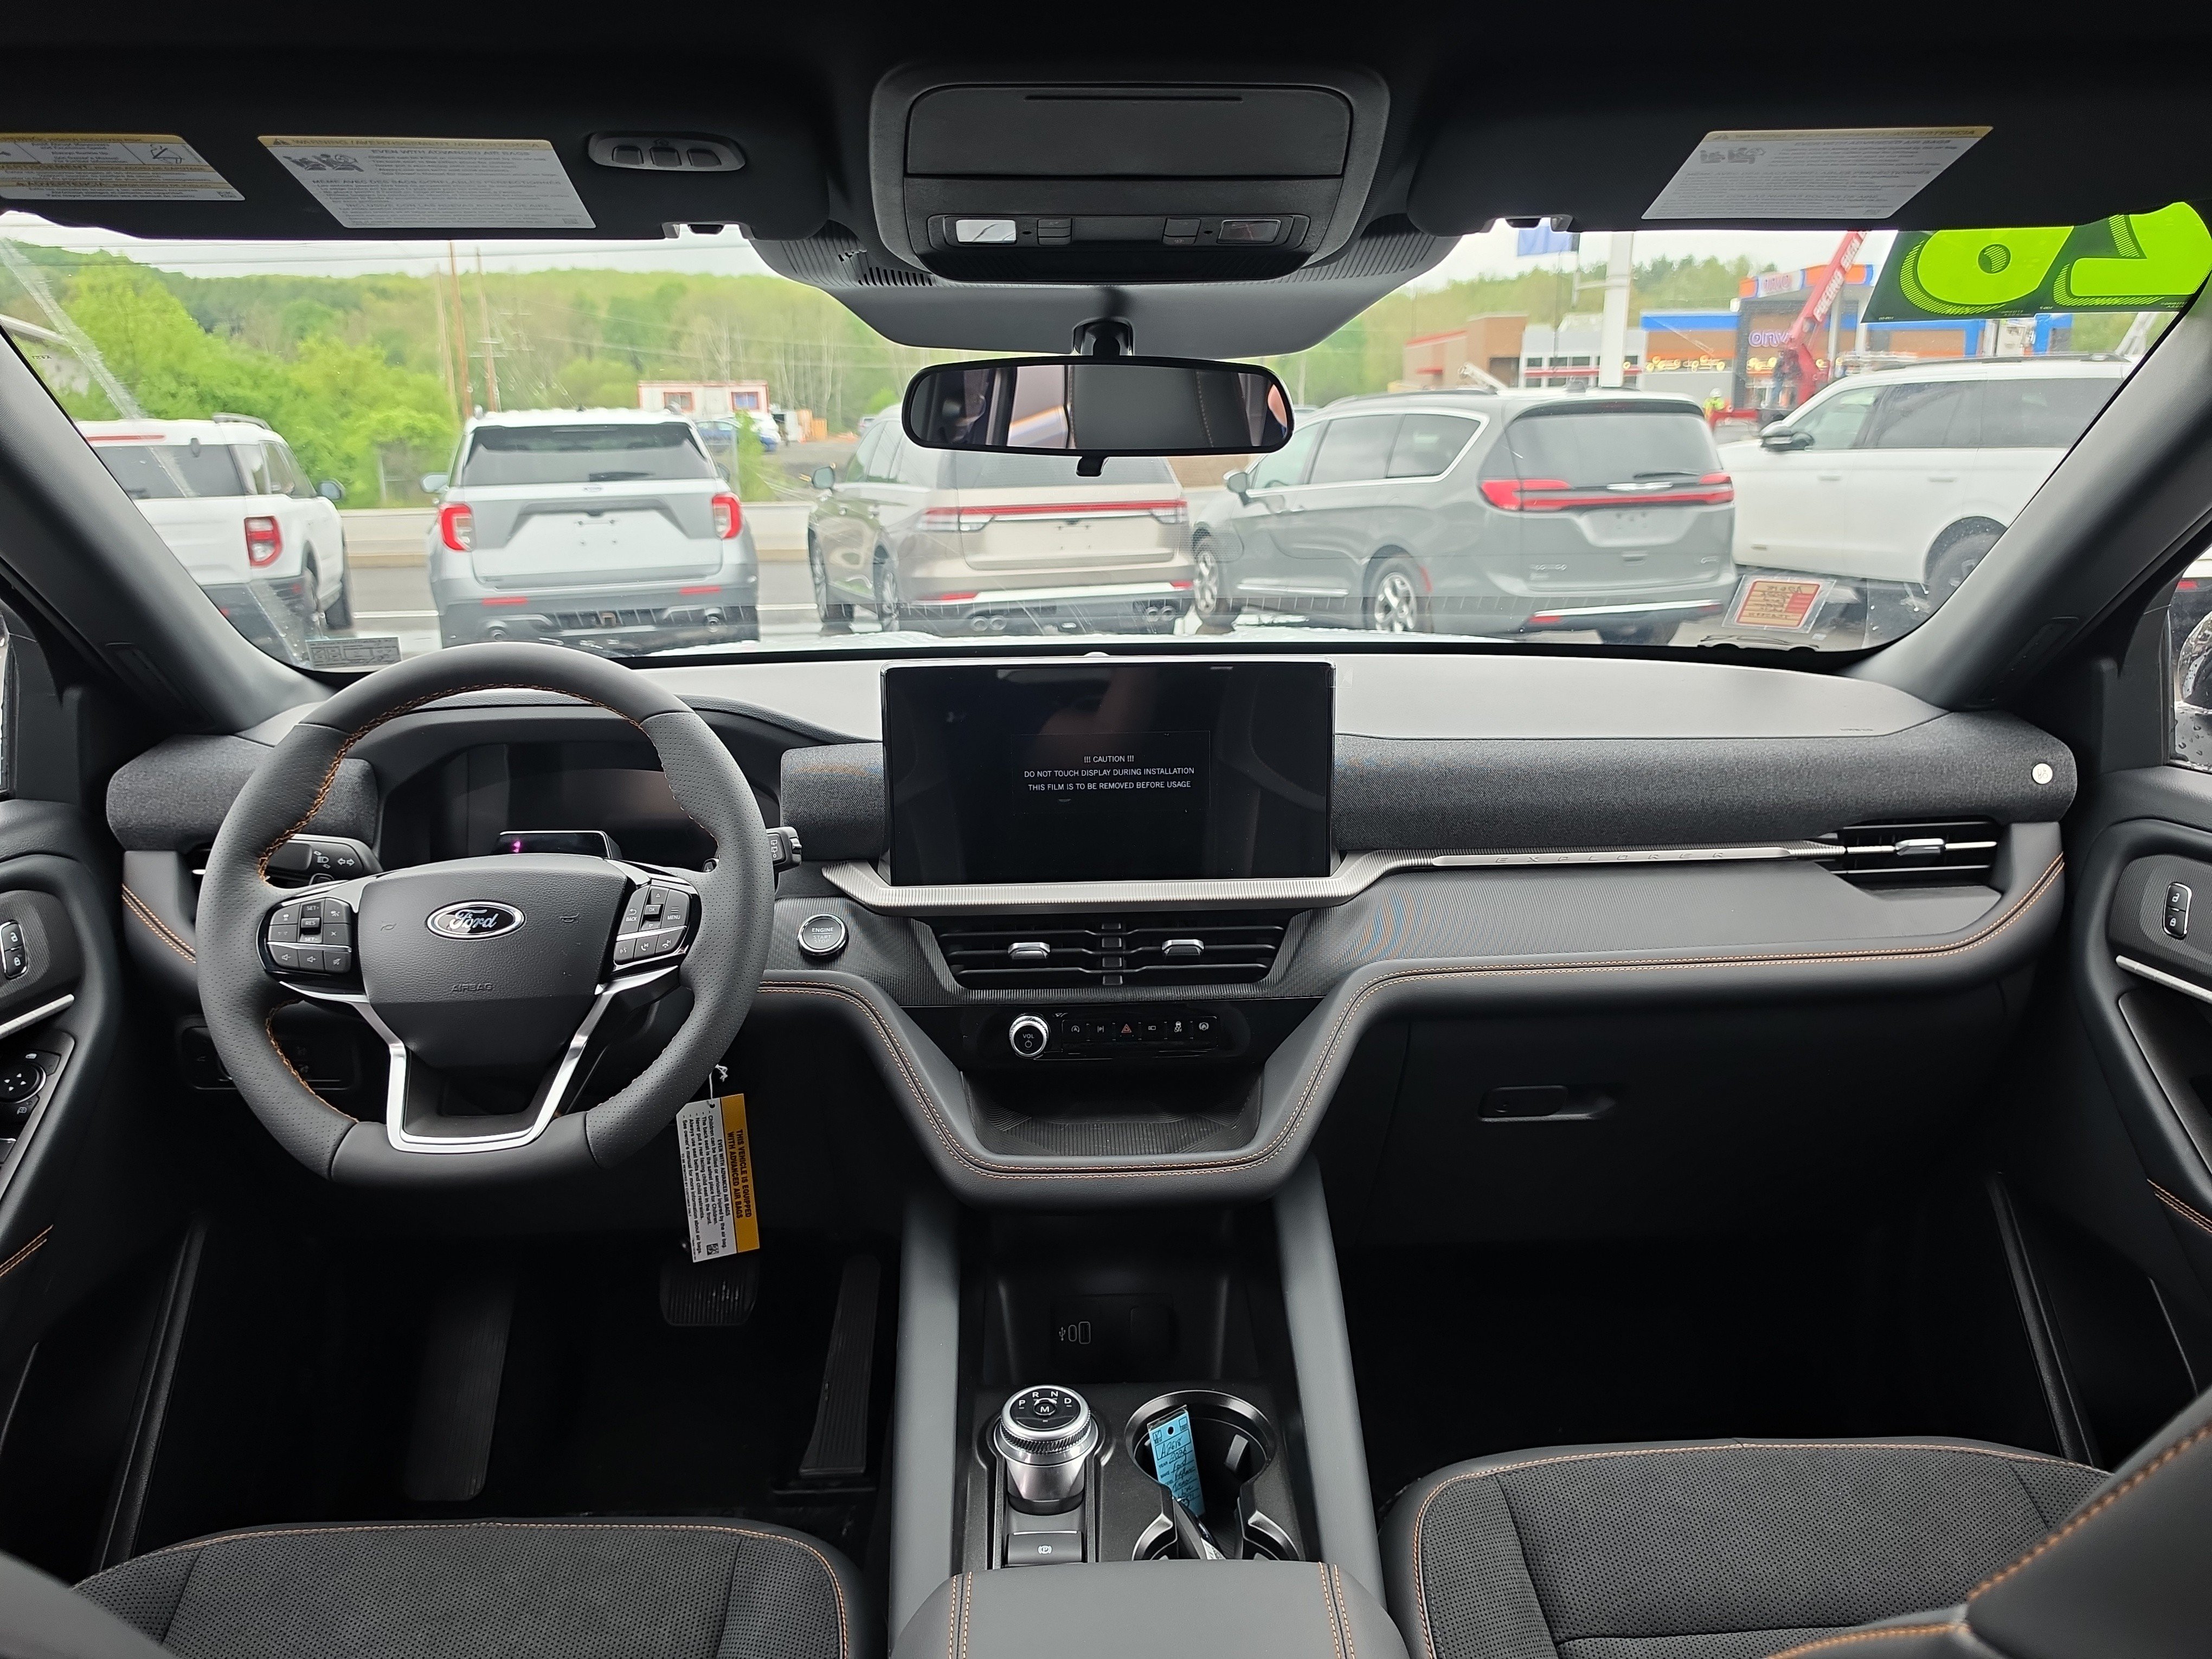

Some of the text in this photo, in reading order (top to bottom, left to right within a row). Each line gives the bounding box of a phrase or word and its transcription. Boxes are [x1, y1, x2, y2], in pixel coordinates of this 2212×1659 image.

[1495, 852, 1723, 863] EXPLORER
[446, 909, 499, 931] Ford
[451, 983, 494, 992] AIRBAG
[727, 1131, 735, 1149] WITH
[729, 1150, 740, 1186] ADVANCED
[738, 1146, 747, 1175] VEHICLE
[735, 1200, 743, 1219] BAGS
[742, 1184, 751, 1218] EQUIPPED
